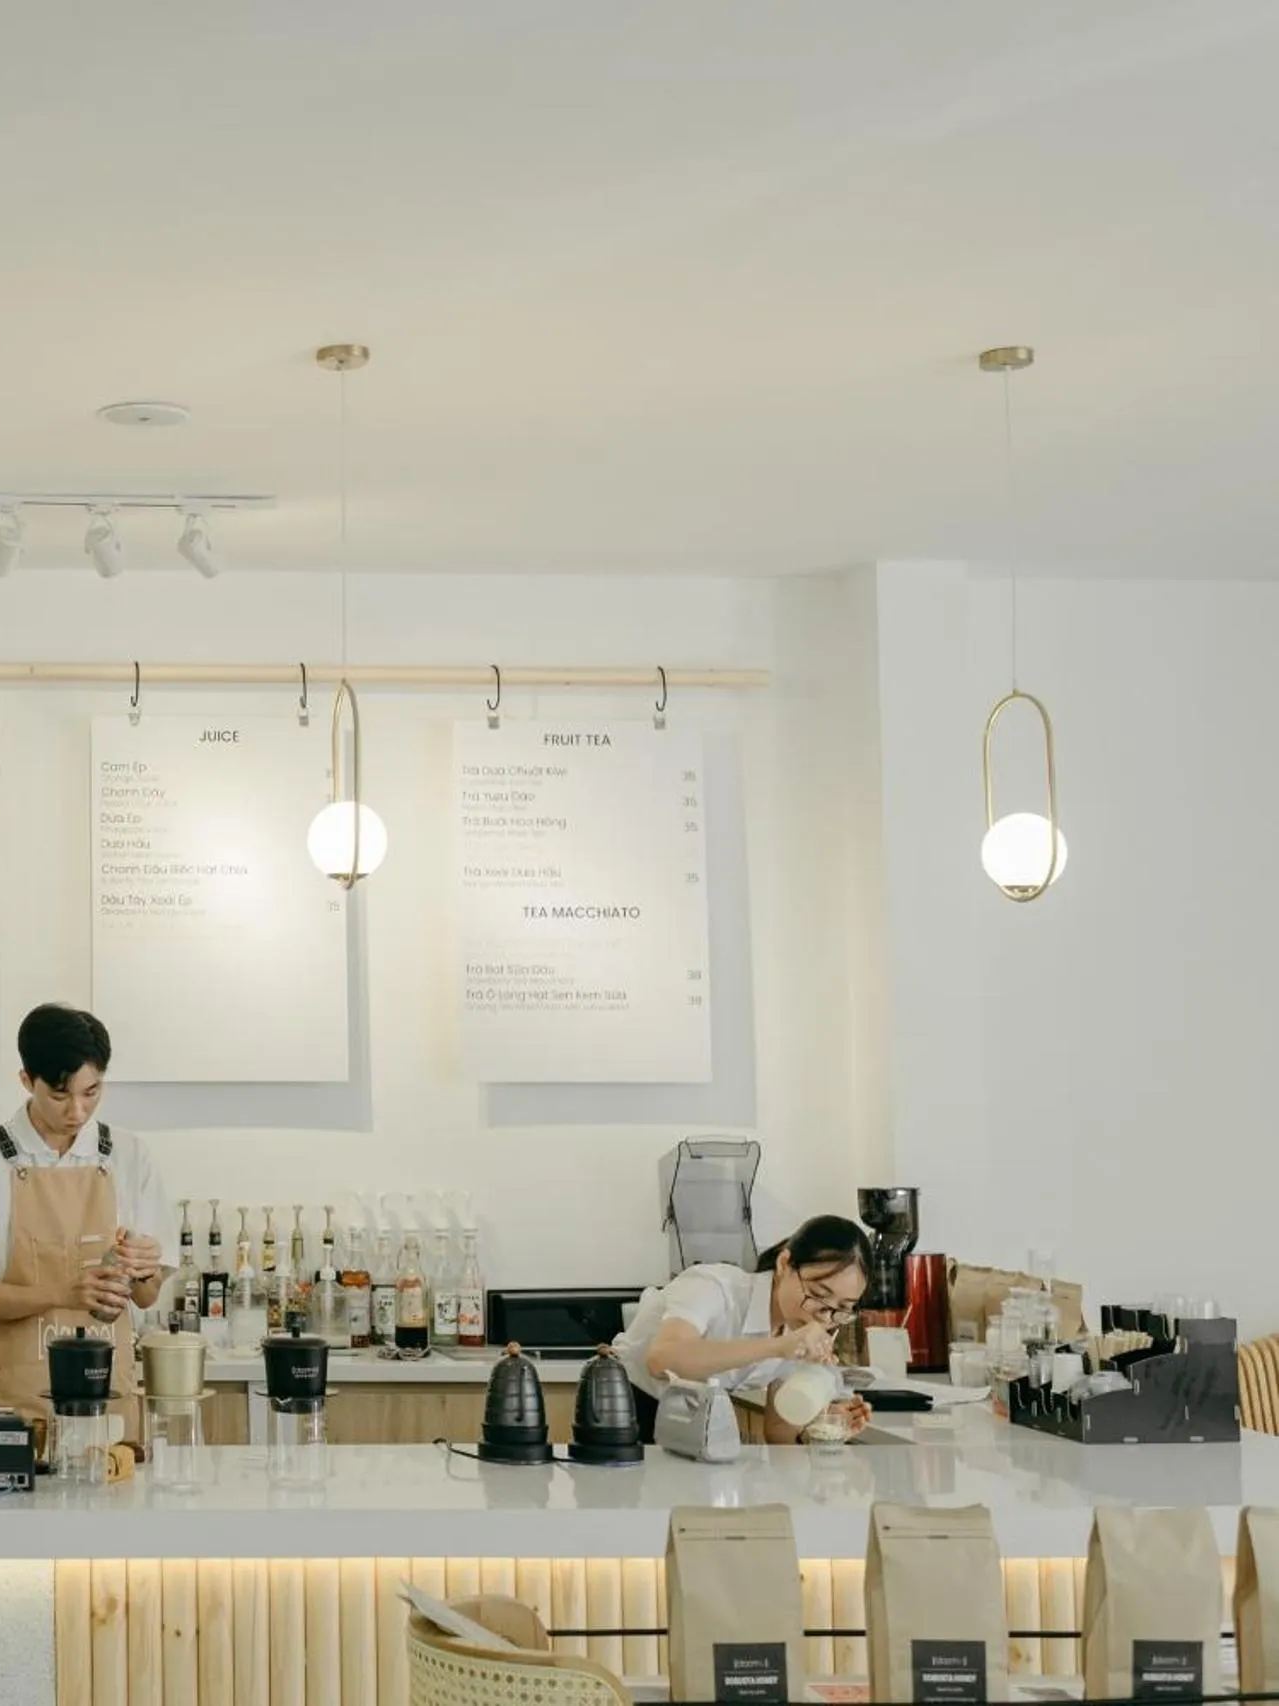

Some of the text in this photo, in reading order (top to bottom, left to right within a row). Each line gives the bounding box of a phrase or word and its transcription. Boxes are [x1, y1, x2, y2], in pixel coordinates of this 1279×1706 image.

[198, 730, 240, 743] JUICE
[544, 734, 612, 746] FRUIT TEA
[101, 762, 129, 773] Cam
[523, 906, 641, 919] TEA MACCHIATO
